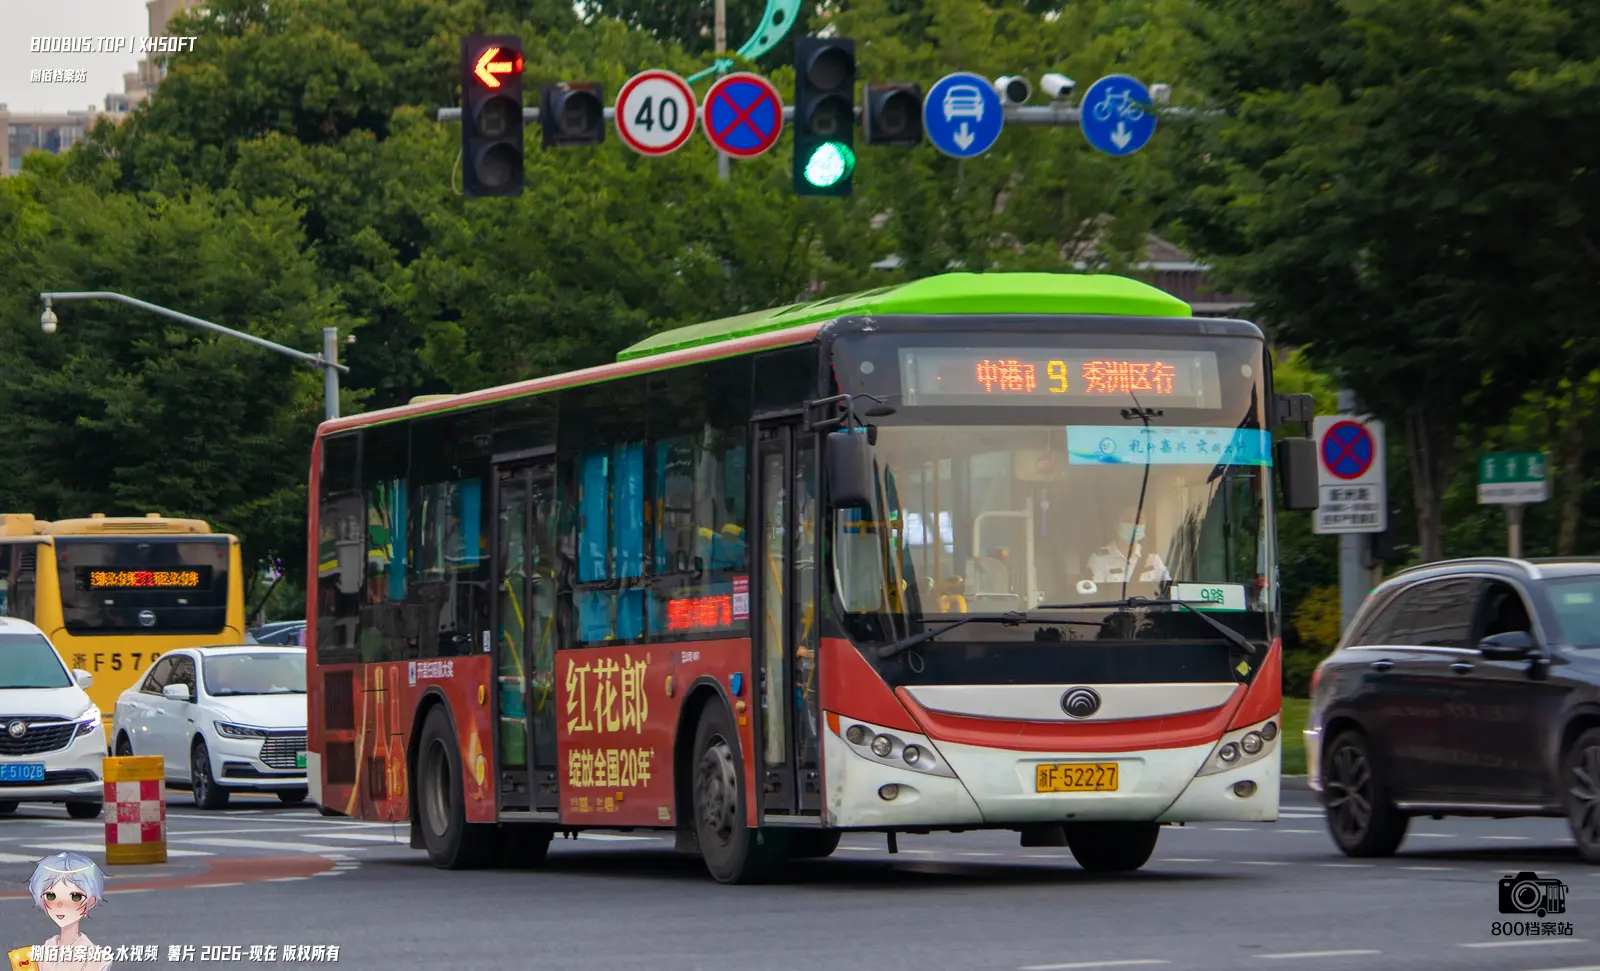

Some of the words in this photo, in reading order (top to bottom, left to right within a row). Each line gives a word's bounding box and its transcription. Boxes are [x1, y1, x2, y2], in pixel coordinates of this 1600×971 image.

[635, 96, 678, 132] 40
[1047, 360, 1068, 393] 9
[1201, 588, 1224, 605] 9路
[565, 653, 649, 735] 红花郎
